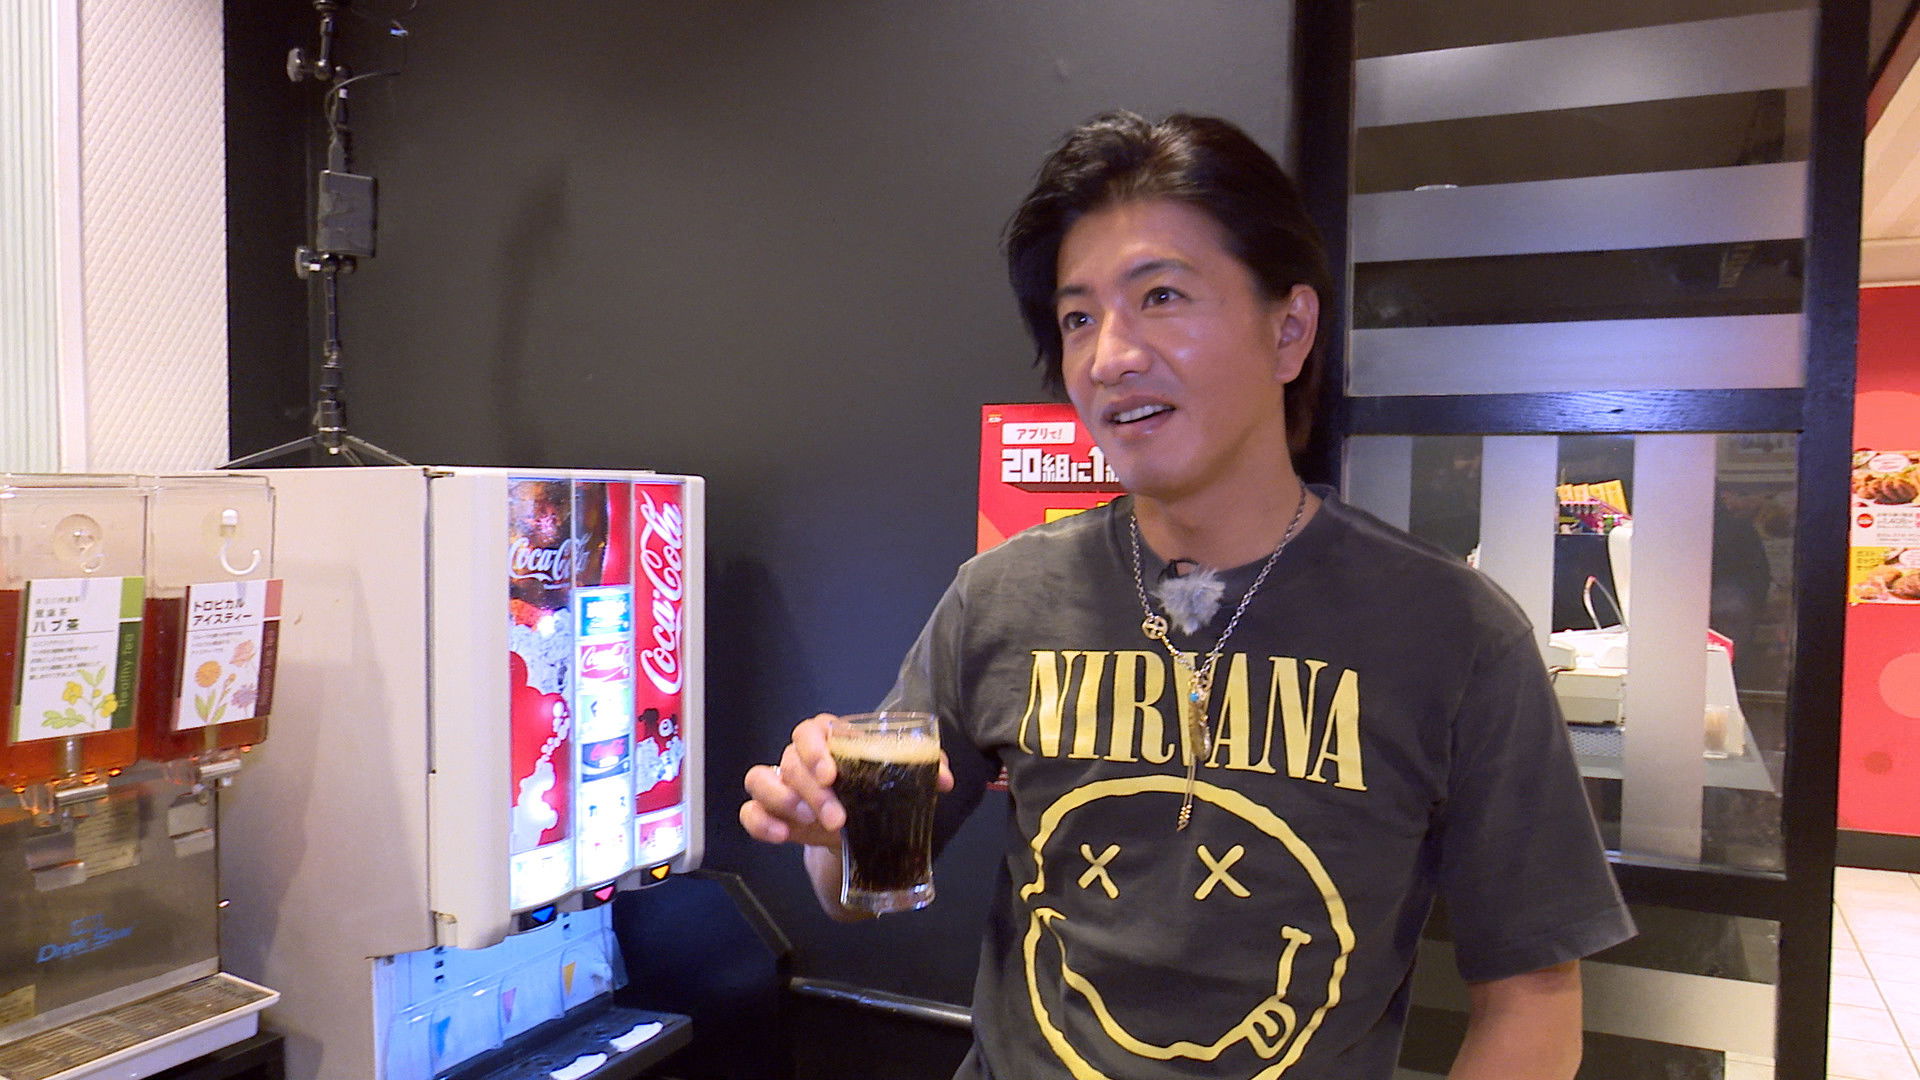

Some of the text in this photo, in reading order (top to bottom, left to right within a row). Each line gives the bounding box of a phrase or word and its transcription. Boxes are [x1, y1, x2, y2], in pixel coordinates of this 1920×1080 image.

[193, 598, 246, 613] トロピカル
[193, 612, 253, 626] アイスティー
[640, 489, 684, 696] Coca-Cola
[1018, 650, 1368, 791] NIRVANA
